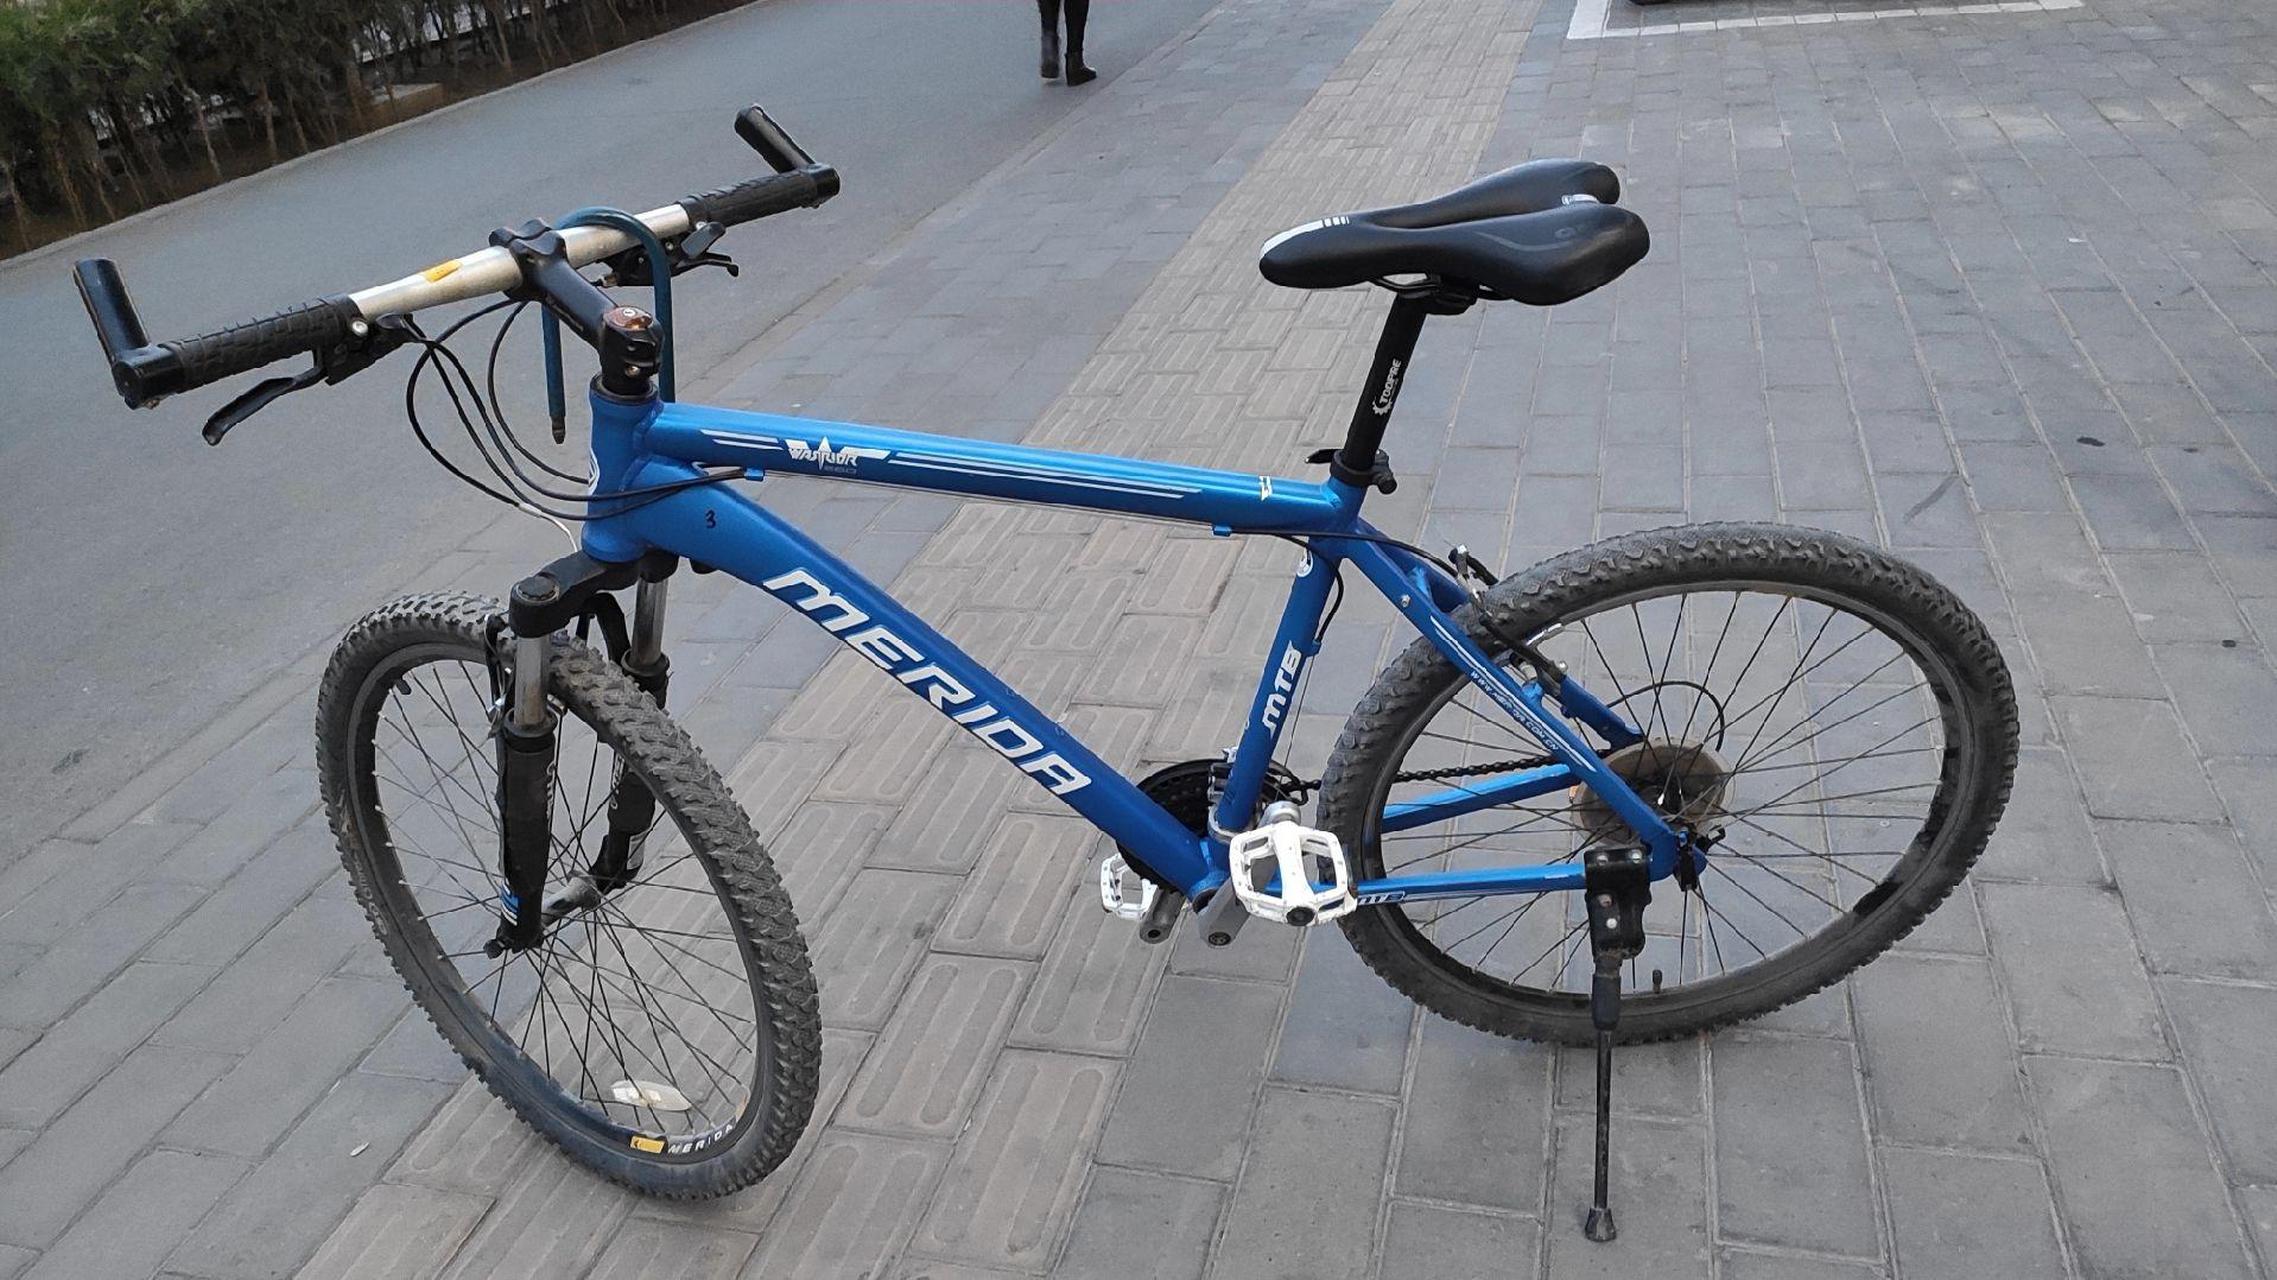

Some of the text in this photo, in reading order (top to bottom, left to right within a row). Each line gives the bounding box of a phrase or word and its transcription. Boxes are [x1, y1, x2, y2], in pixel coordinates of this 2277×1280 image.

[705, 509, 716, 528] 3
[763, 568, 1091, 794] MERIDA
[1262, 640, 1301, 739] MTB
[668, 1124, 733, 1154] MERIDA
